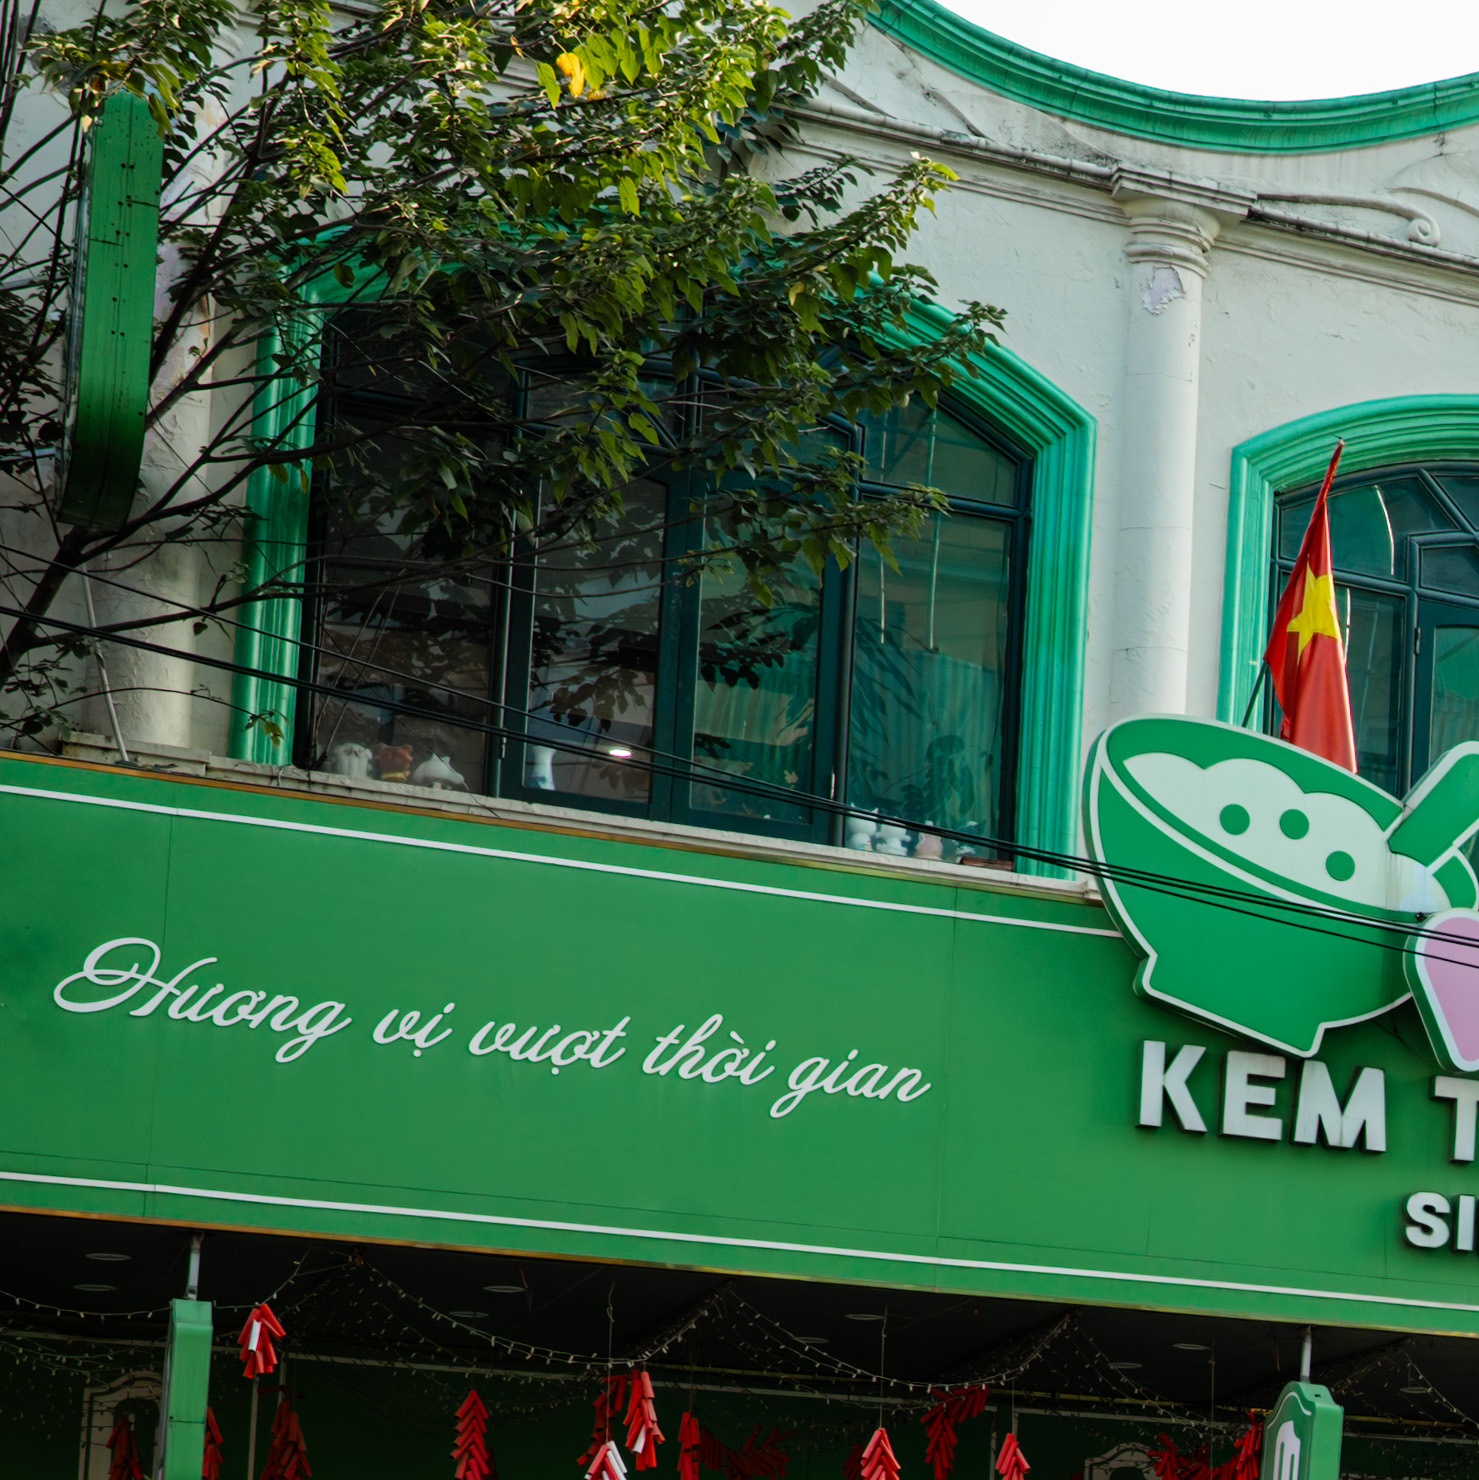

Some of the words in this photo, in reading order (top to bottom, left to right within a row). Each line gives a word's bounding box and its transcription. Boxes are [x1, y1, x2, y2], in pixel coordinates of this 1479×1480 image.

[54, 937, 352, 1063] Hương
[373, 1002, 454, 1058] vị
[468, 1016, 631, 1076] vượt
[642, 1013, 777, 1086] thời
[769, 1048, 932, 1119] gian
[1136, 1039, 1387, 1154] KEM
